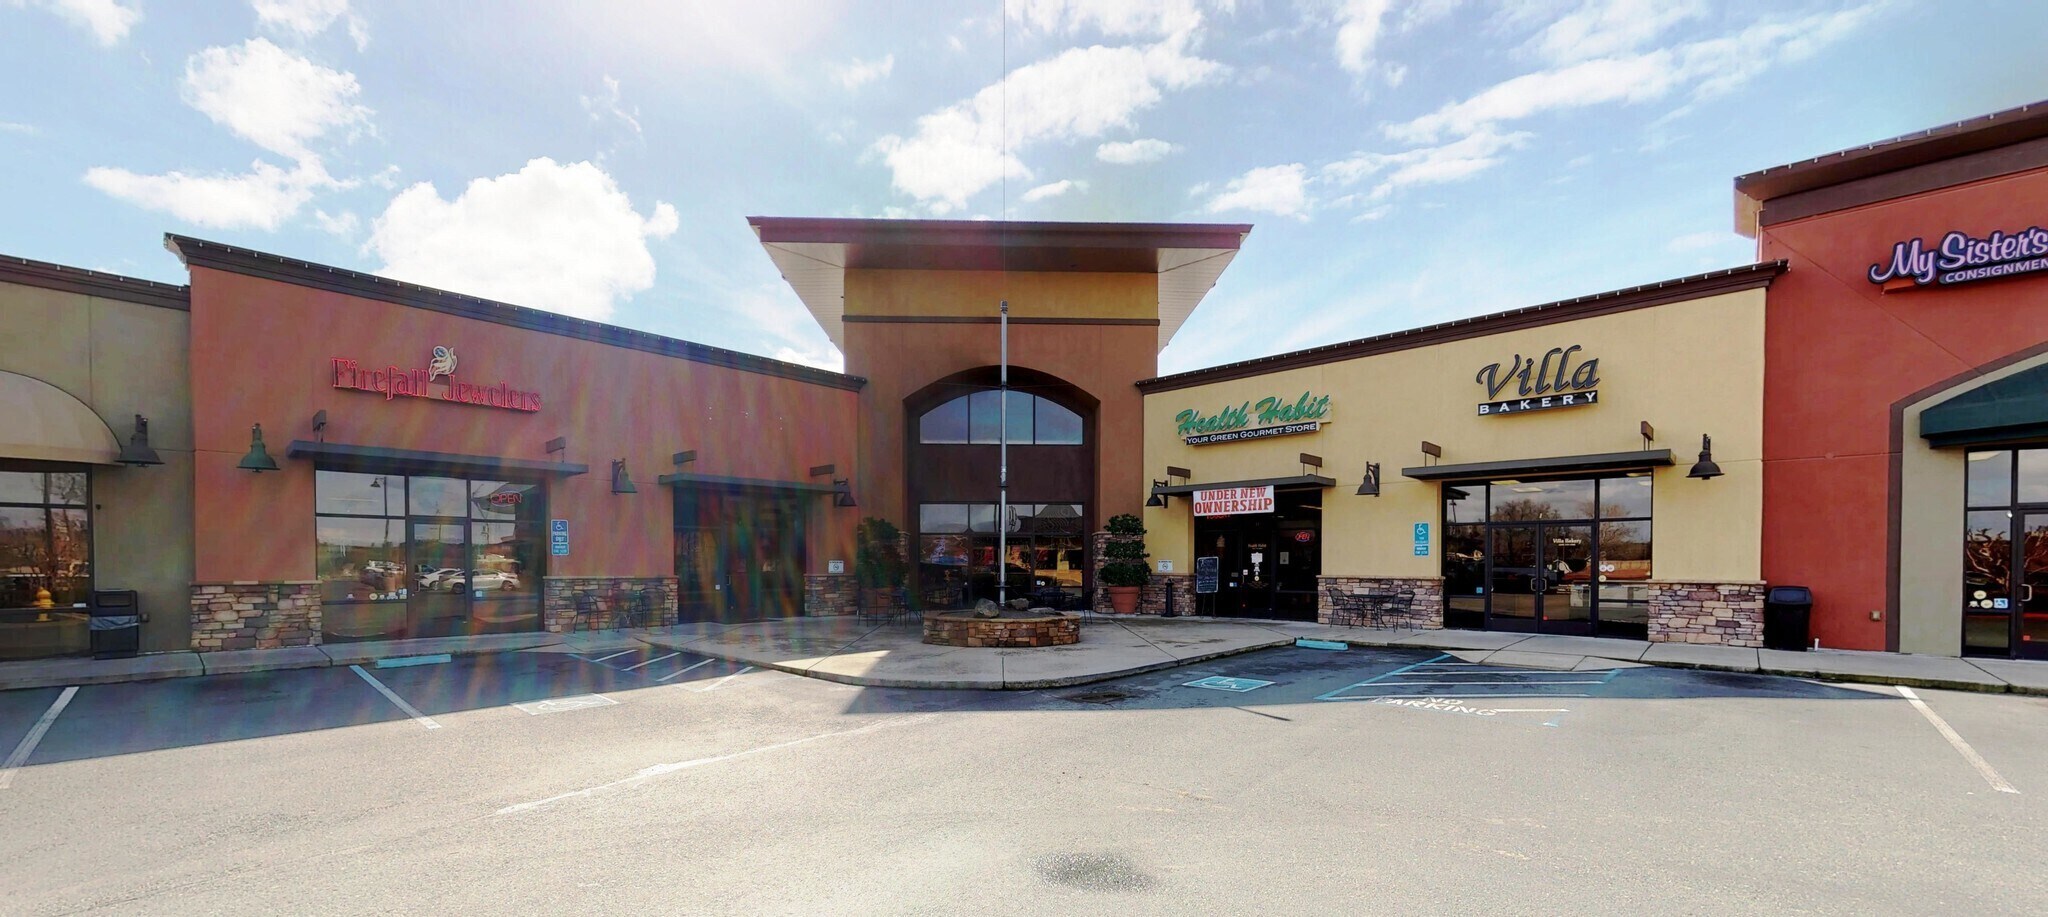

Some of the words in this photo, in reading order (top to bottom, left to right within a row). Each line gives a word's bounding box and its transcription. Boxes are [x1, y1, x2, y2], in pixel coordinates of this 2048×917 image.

[1870, 239, 1935, 283] My
[1938, 227, 2048, 268] Sister's
[1476, 344, 1600, 400] Villa
[331, 357, 429, 400] Firefall
[441, 374, 542, 412] Jewelers
[1175, 400, 1250, 435] Health
[1254, 390, 1330, 425] Habit
[1480, 391, 1596, 414] BAKERY
[1186, 436, 1209, 445] YOUR
[1210, 433, 1238, 442] GREEN
[1239, 427, 1283, 439] GOURMET
[1285, 424, 1316, 434] STORE
[491, 493, 522, 504] OPEN
[1194, 497, 1273, 514] OWNERSHIP
[1200, 489, 1237, 502] UNDER
[1240, 487, 1267, 499] NEW
[1371, 697, 1497, 715] PARKING
